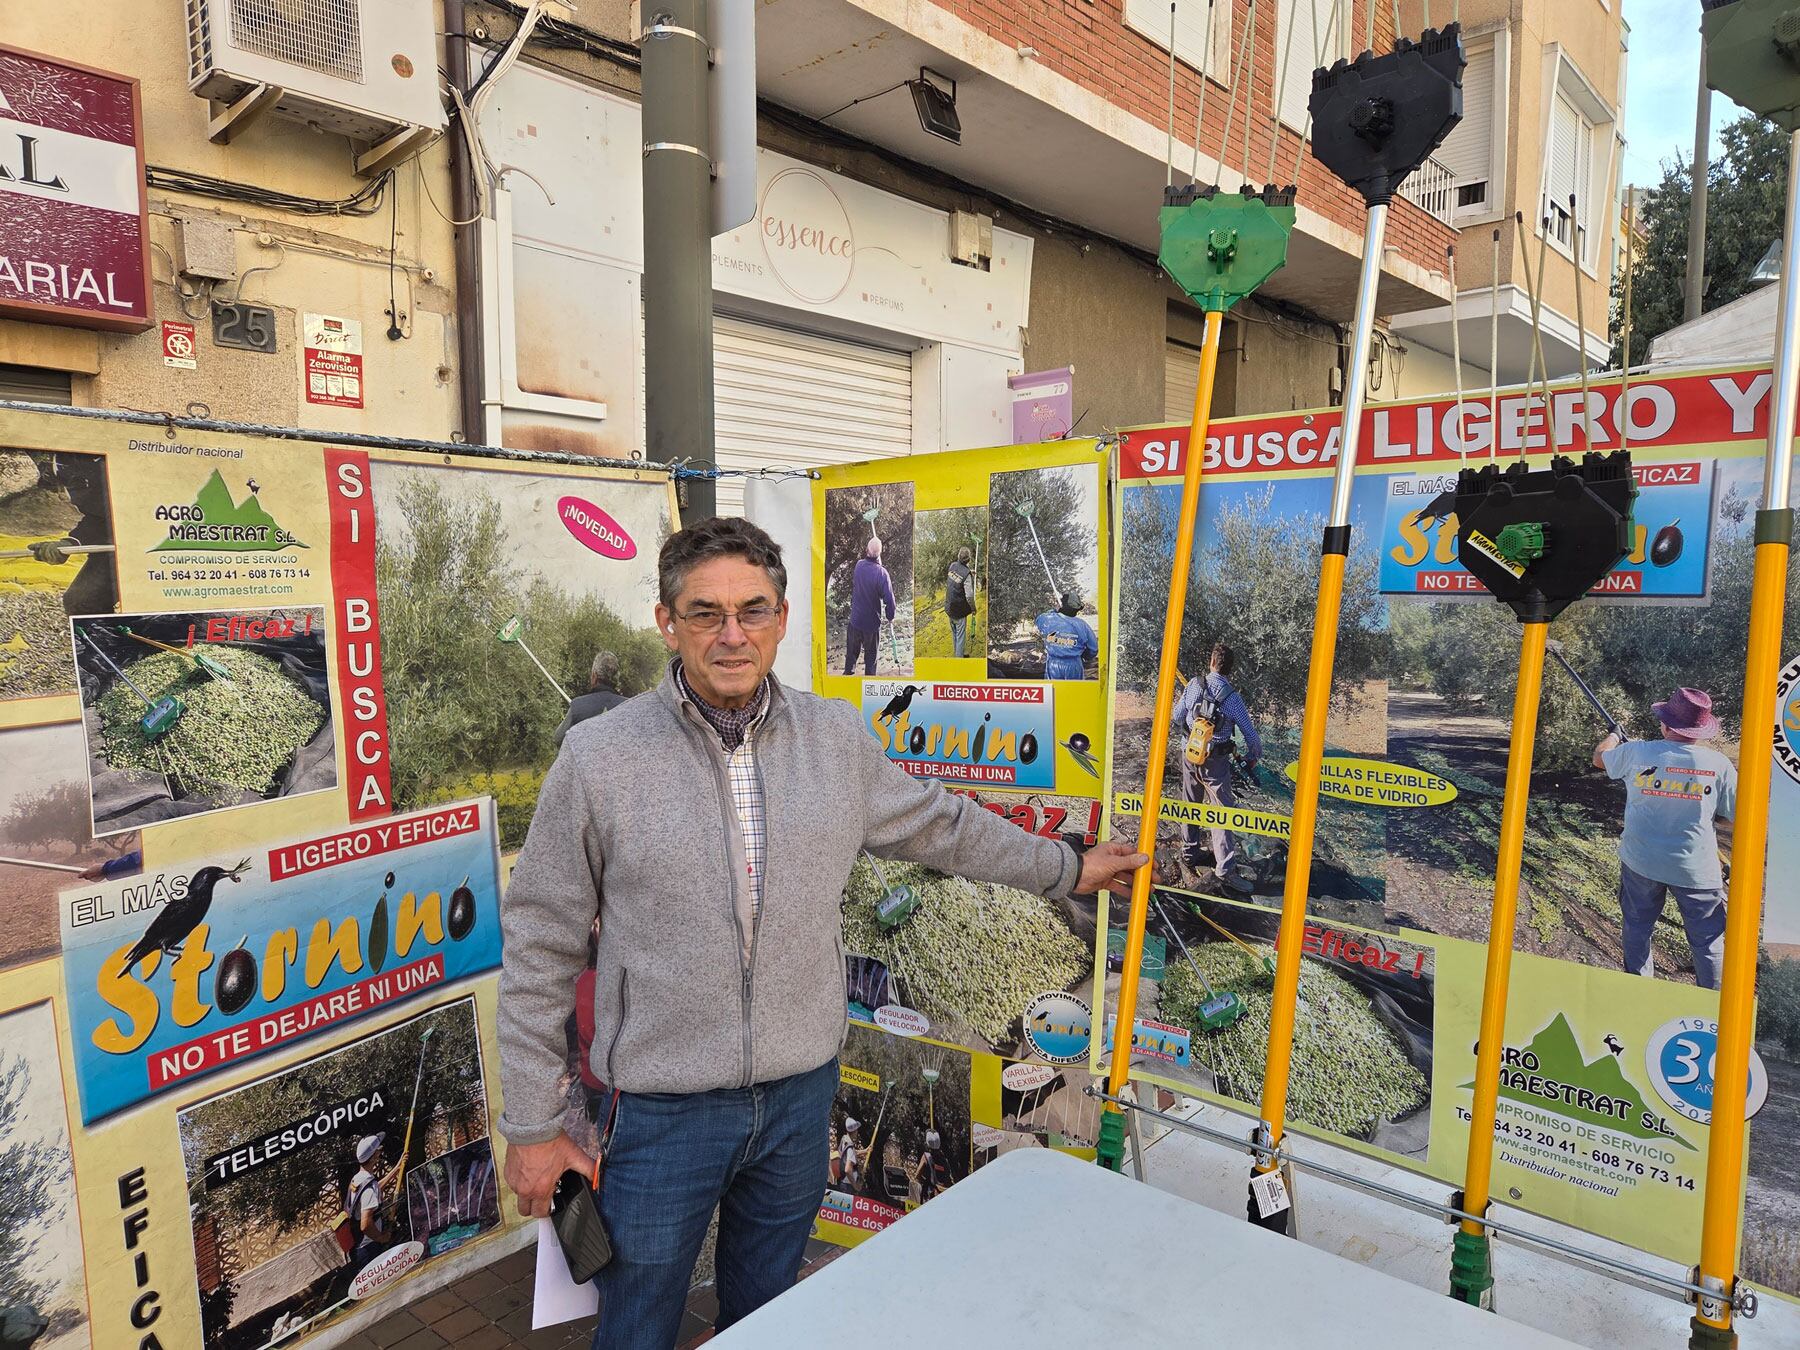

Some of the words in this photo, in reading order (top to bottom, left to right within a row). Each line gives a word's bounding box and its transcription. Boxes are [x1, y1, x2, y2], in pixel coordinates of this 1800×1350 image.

[763, 216, 851, 258] essence
[712, 253, 763, 276] PLEMENTS
[869, 294, 904, 312] PERFUMS
[217, 306, 269, 347] 25
[309, 359, 359, 373] Zerovision
[317, 350, 351, 363] Alarma
[1140, 439, 1179, 473] SI
[1201, 426, 1342, 469] BUSCA
[1372, 384, 1678, 459] LIGERO
[128, 439, 194, 455] Distribuidor
[196, 447, 243, 459] nacional
[1393, 481, 1414, 496] EL
[1418, 475, 1458, 495] MÁS
[155, 505, 204, 522] AGRO
[169, 524, 269, 542] MAESTRAT
[275, 530, 296, 543] S.L.
[563, 504, 628, 553] ¡NOVEDAD!
[160, 556, 232, 565] COMPROMISO
[236, 556, 249, 564] DE
[252, 555, 298, 564] SERVICIO
[148, 571, 168, 581] Tel.
[171, 571, 190, 580] 964
[194, 570, 207, 580] 32
[209, 570, 222, 580] 20
[225, 570, 238, 580] 41
[248, 570, 267, 579] 608
[270, 570, 282, 579] 76
[285, 569, 297, 579] 73
[299, 569, 310, 578] 14
[1424, 575, 1450, 588] NO
[1455, 575, 1477, 588] TE
[162, 585, 294, 599] www.agromaestrat.com
[206, 617, 296, 643] Eficaz
[865, 684, 878, 697] EL
[880, 682, 903, 697] MÁS
[937, 687, 979, 699] LIGERO
[982, 688, 991, 699] Y
[994, 688, 1040, 701] EFICAZ
[870, 711, 1038, 765] Stornino
[907, 762, 921, 774] TE
[924, 762, 967, 778] DEJARÉ
[970, 767, 982, 779] NI
[986, 768, 1013, 781] UNA
[1367, 770, 1447, 791] FLEXIBLES
[1355, 785, 1374, 798] DE
[1378, 788, 1428, 806] VIDRIO
[1121, 798, 1143, 812] SIN
[1159, 802, 1200, 822] AÑAR
[1205, 810, 1227, 825] SU
[1232, 814, 1290, 835] OLIVAR
[280, 831, 372, 874] LIGERO
[376, 827, 390, 850] Y
[397, 809, 475, 844] EFICAZ
[70, 897, 115, 929] EL
[121, 874, 189, 914] MÁS
[1301, 925, 1401, 974] Eficaz
[91, 868, 477, 1055] Stornino
[160, 1044, 205, 1081] NO
[213, 1032, 251, 1061] TE
[258, 984, 362, 1045] DEJARÉ
[368, 979, 391, 1002] NI
[395, 960, 441, 994] UNA
[879, 1008, 919, 1023] REGULADOR
[1026, 1002, 1036, 1017] SU
[878, 1017, 888, 1025] DE
[889, 1018, 926, 1034] VELOCIDAD
[1025, 1028, 1048, 1059] MARCA
[1004, 1064, 1043, 1078] VARILLAS
[1007, 1072, 1052, 1089] FLEXIBLES
[1641, 1112, 1675, 1136] S.L.
[212, 1091, 386, 1180] TELESCÓPICA
[1576, 1125, 1596, 1141] DE
[1601, 1134, 1676, 1164] SERVICIO
[1514, 1126, 1532, 1140] 32
[1537, 1132, 1554, 1147] 20
[1559, 1140, 1576, 1154] 41
[1592, 1149, 1620, 1168] 608
[1625, 1159, 1644, 1175] 76
[1649, 1166, 1669, 1183] 73
[1675, 1175, 1695, 1191] 14
[1499, 1150, 1567, 1181] Distribuidor
[1568, 1174, 1619, 1197] nacional
[855, 1199, 869, 1211] da
[820, 1208, 839, 1221] con
[842, 1212, 859, 1226] los
[862, 1217, 883, 1231] dos
[354, 1247, 410, 1286] REGULADOR
[356, 1284, 370, 1297] DE
[370, 1252, 420, 1287] VELOCIDAD
